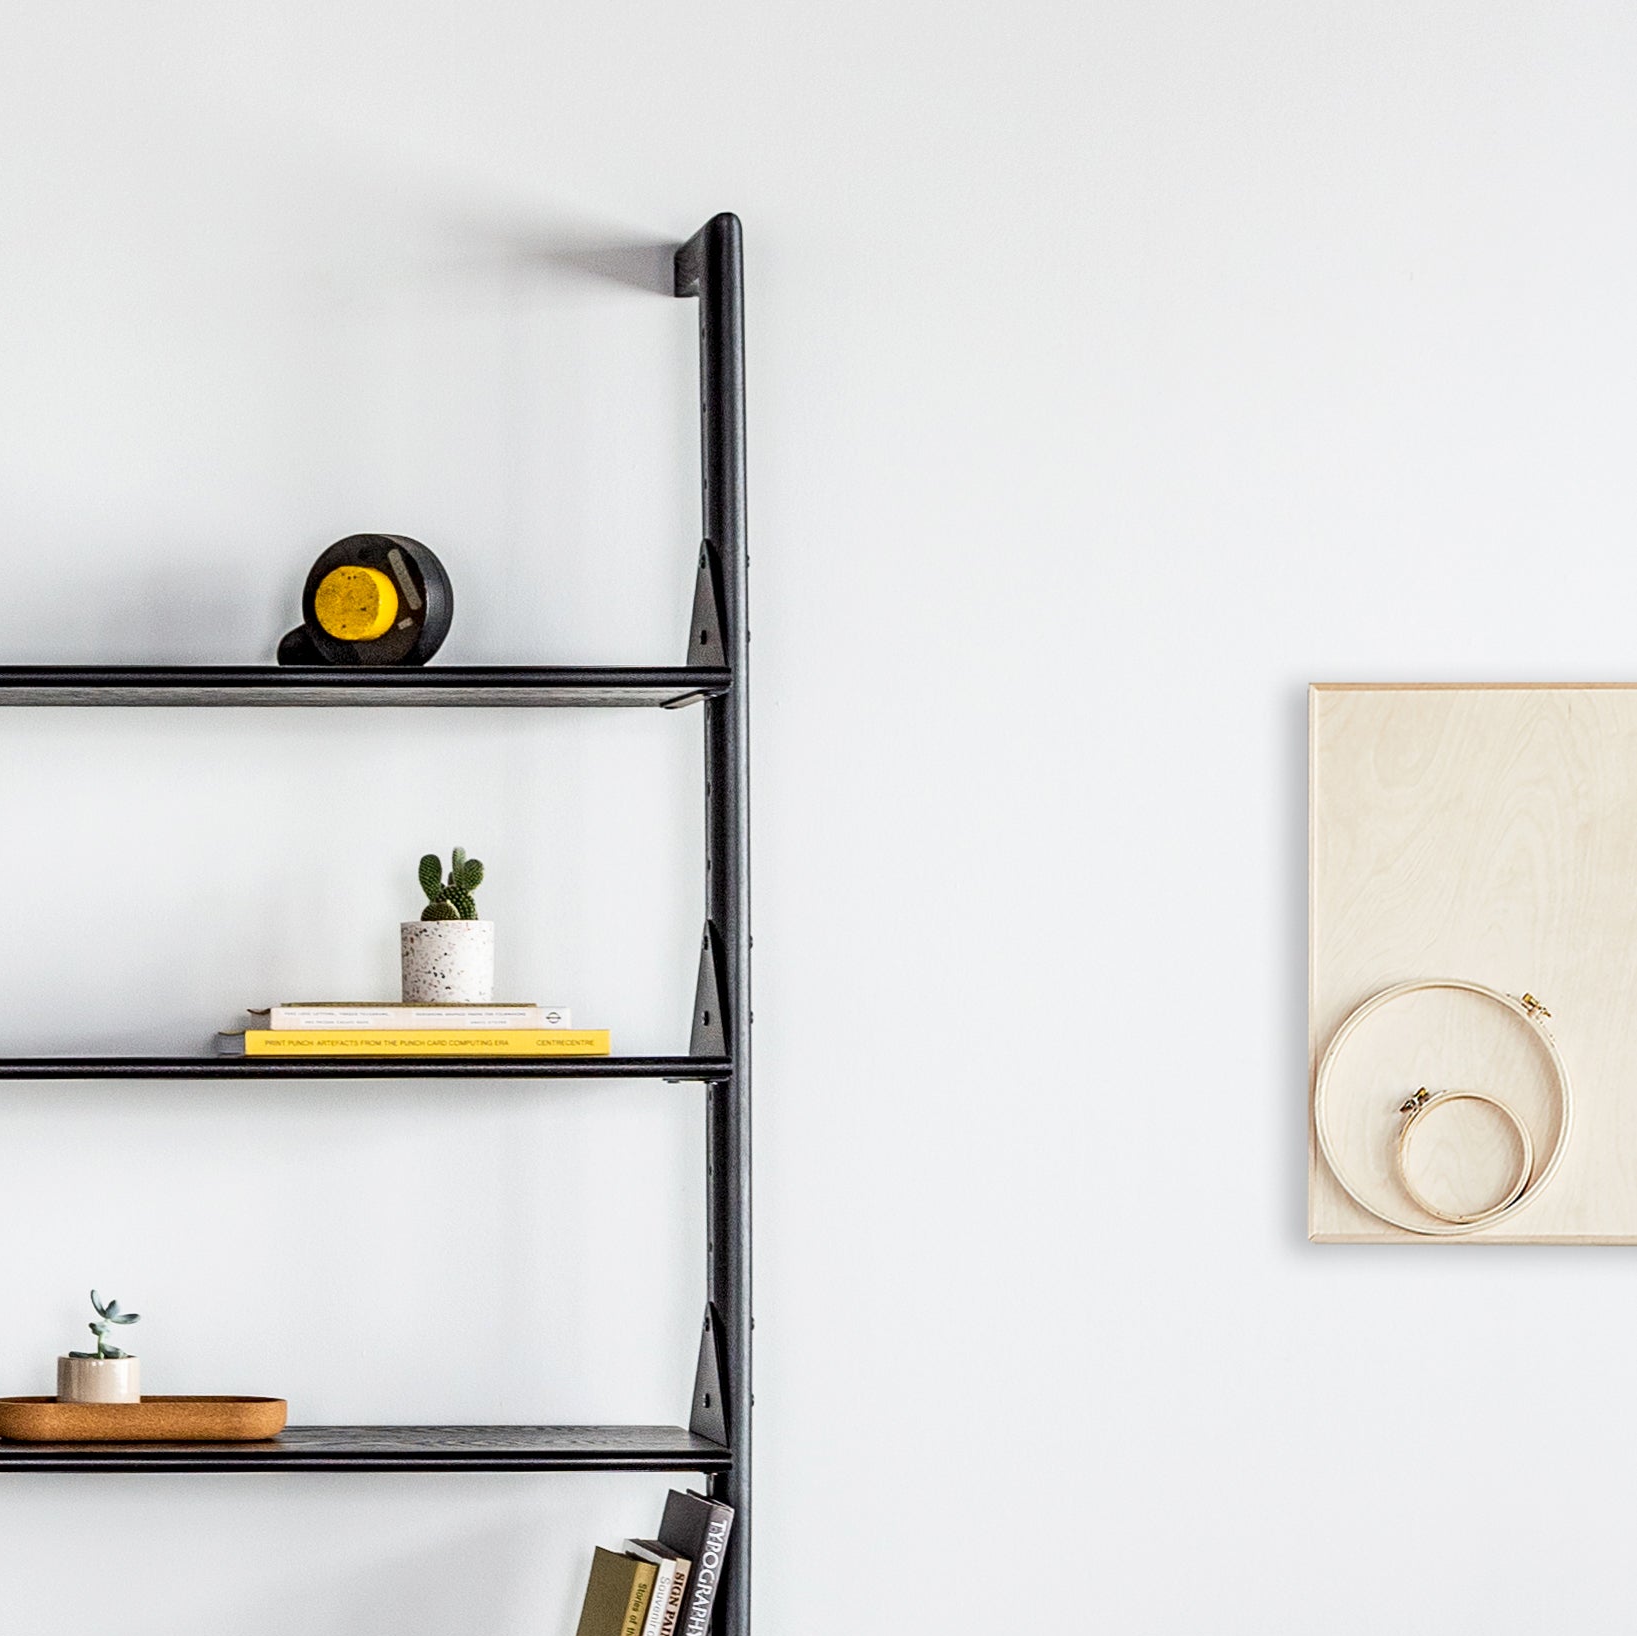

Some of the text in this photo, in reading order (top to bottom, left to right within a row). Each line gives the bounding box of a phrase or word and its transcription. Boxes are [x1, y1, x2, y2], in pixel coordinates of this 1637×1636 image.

[632, 1583, 647, 1612] Stories
[649, 1576, 671, 1628] Souvenir
[668, 1572, 685, 1607] SIGN
[629, 1614, 638, 1625] of
